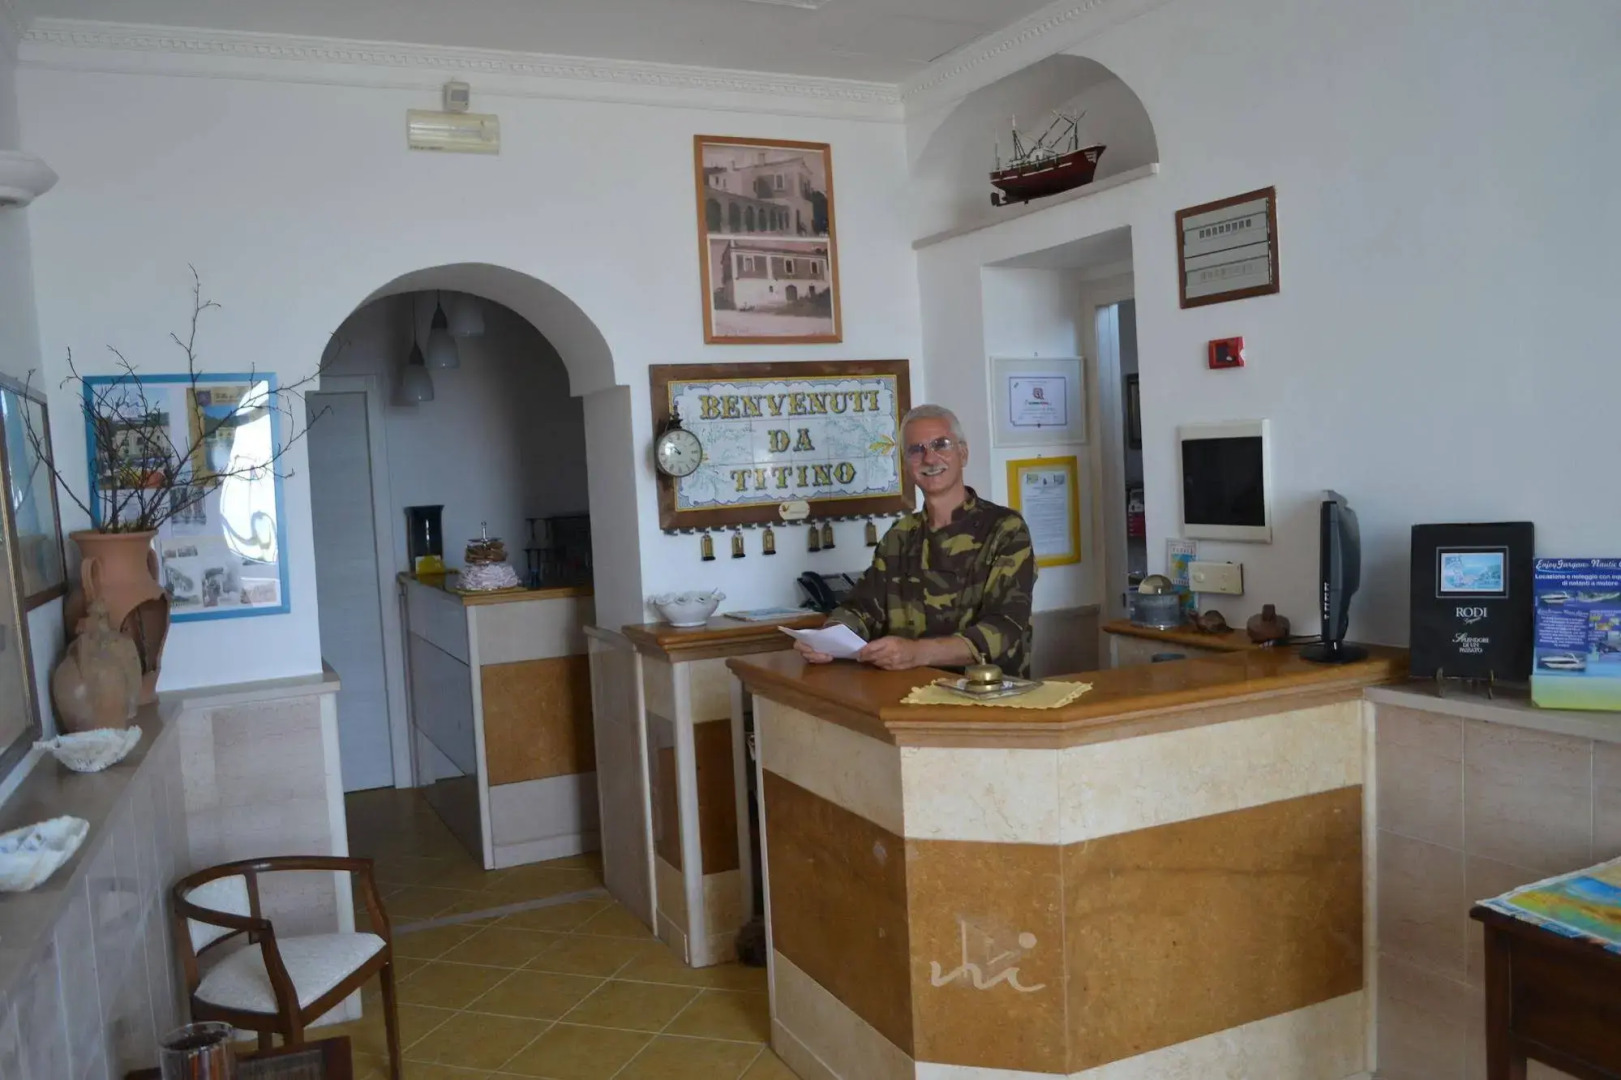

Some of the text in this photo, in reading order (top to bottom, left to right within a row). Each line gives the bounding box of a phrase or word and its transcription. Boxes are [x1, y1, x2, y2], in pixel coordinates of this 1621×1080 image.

[699, 390, 880, 420] BENVENUTI
[768, 428, 815, 453] DA
[730, 462, 857, 492] TITINO
[1456, 607, 1488, 618] RODI
